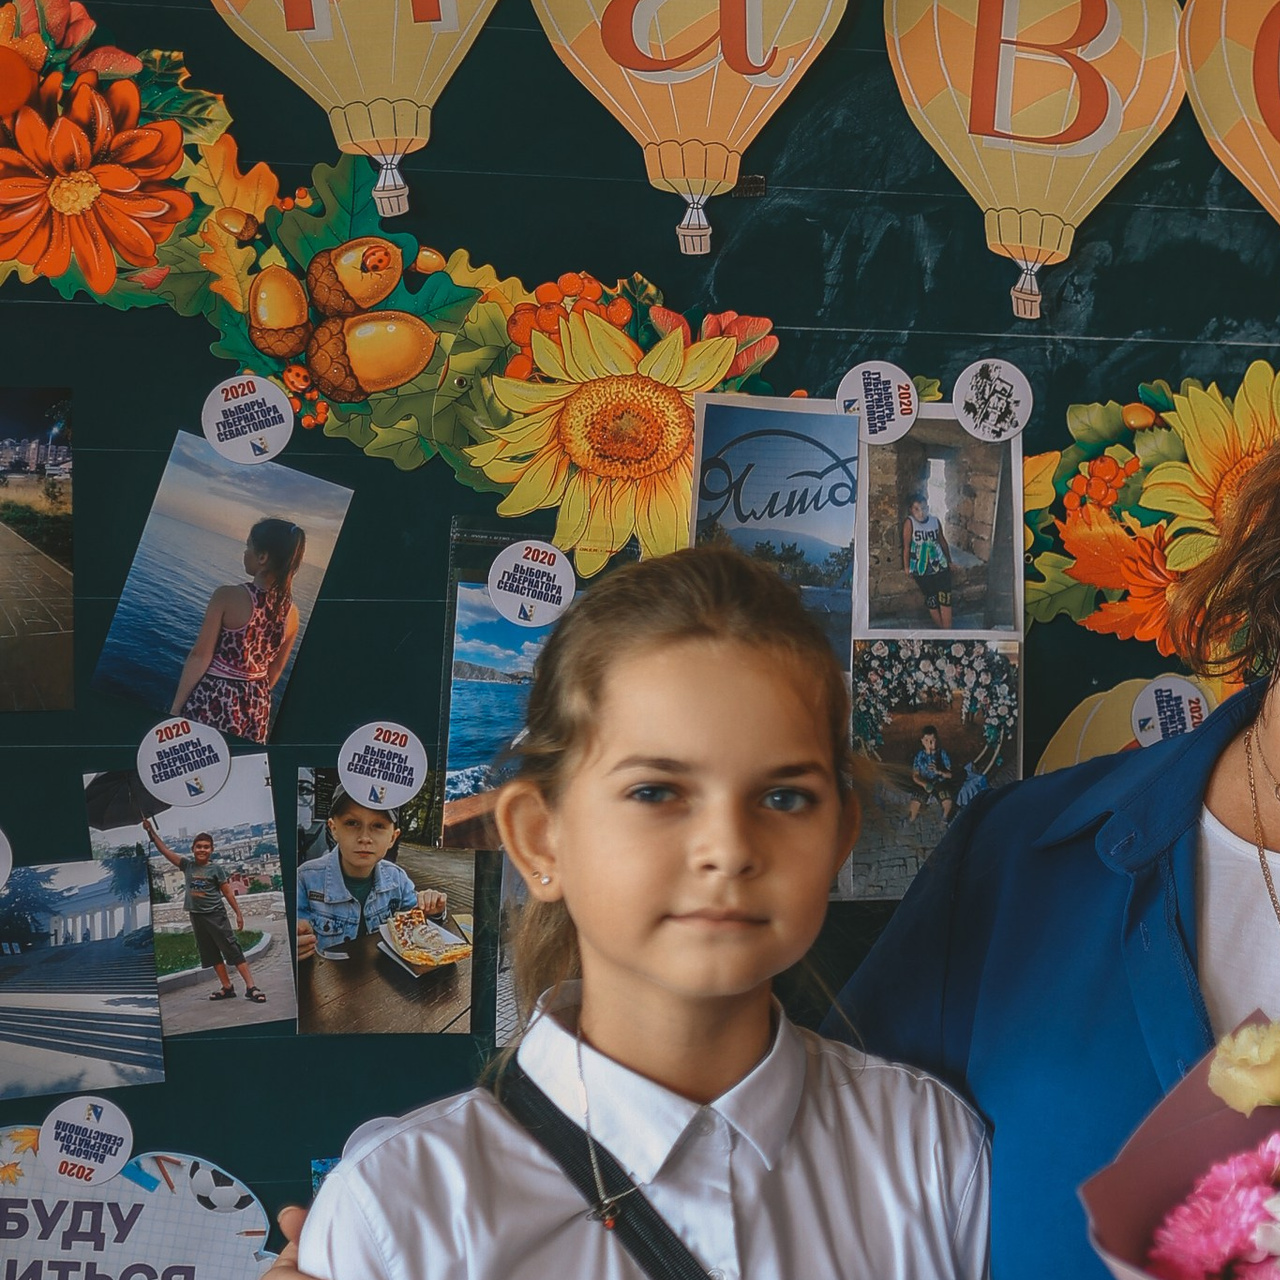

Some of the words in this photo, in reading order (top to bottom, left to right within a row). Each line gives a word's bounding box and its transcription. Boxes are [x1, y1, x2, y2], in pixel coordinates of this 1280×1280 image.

[220, 378, 257, 402] 2020
[860, 369, 878, 435] СЕВАСТОПОЛЯ
[870, 371, 887, 432] ГУБЕРНАТОРА
[880, 378, 895, 422] ВЫБОРЫ
[896, 382, 914, 416] 2020
[214, 403, 280, 432] ГУБЕРНАТОРА
[220, 397, 267, 419] ВЫБОРЫ
[216, 412, 285, 443] СЕВАСТОПОЛЯ
[521, 545, 557, 567] 2020
[501, 569, 563, 595] ГУБЕРНАТОРА
[512, 563, 556, 583] ВЫБОРЫ
[496, 579, 562, 605] СЕВАСТОПОЛЯ
[154, 720, 192, 744] 2020
[373, 726, 409, 748] 2020
[149, 744, 214, 773] ГУБЕРНАТОРА
[155, 736, 202, 761] ВЫБОРЫ
[362, 744, 408, 764] ВЫБОРЫ
[150, 752, 221, 785] СЕВАСТОПОЛЯ
[345, 761, 414, 788] СЕВАСТОПОЛЯ
[351, 751, 415, 777] ГУБЕРНАТОРА
[53, 1119, 125, 1147] СЕВАСТОПОЛЯ
[53, 1130, 119, 1157] ГУБЕРНАТОРА
[59, 1142, 106, 1164] ВЫБОРЫ
[57, 1159, 95, 1181] 2020
